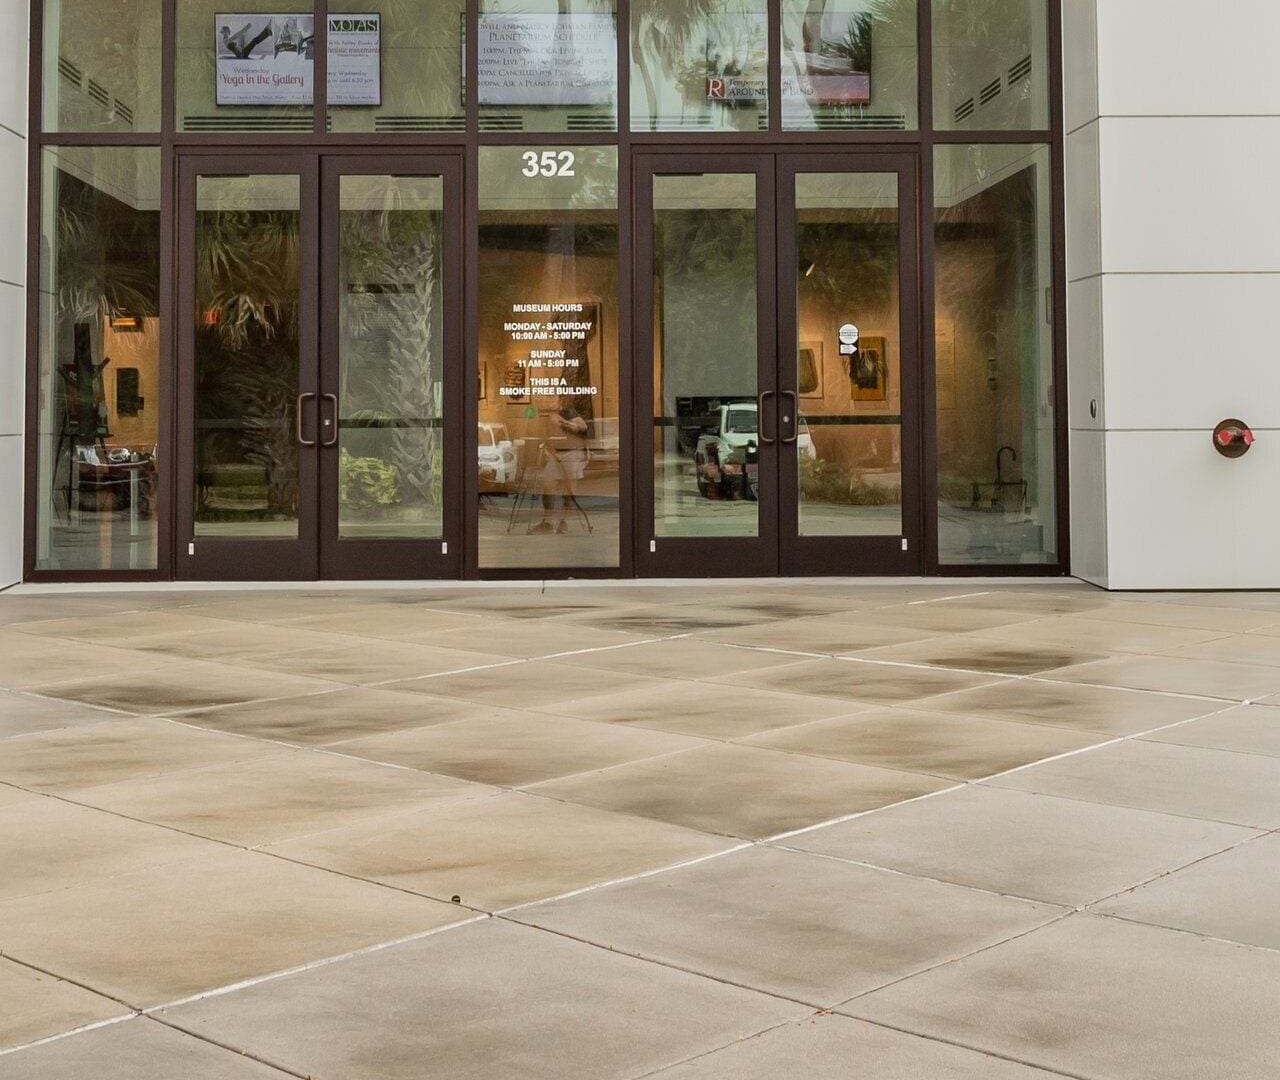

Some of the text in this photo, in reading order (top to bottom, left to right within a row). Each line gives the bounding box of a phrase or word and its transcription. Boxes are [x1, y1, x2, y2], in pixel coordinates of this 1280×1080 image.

[233, 66, 270, 75] Wednesday
[219, 74, 304, 87] Yoga in the Gallery
[521, 151, 575, 178] 352
[513, 304, 583, 312] MUSEUM HOURS
[504, 323, 541, 331] MONDAY
[546, 322, 592, 330] SATURDAY
[511, 332, 533, 340] 10:00
[534, 332, 548, 340] AM
[553, 332, 571, 340] 5:00
[572, 331, 585, 340] PM
[530, 350, 566, 358] SUNDAY
[518, 360, 526, 368] 11
[527, 360, 542, 368] AM
[547, 359, 565, 367] 5:00
[565, 359, 579, 367] PM
[529, 378, 567, 386] THIS IS A
[499, 387, 598, 395] SMOKE FREE BUILDING
